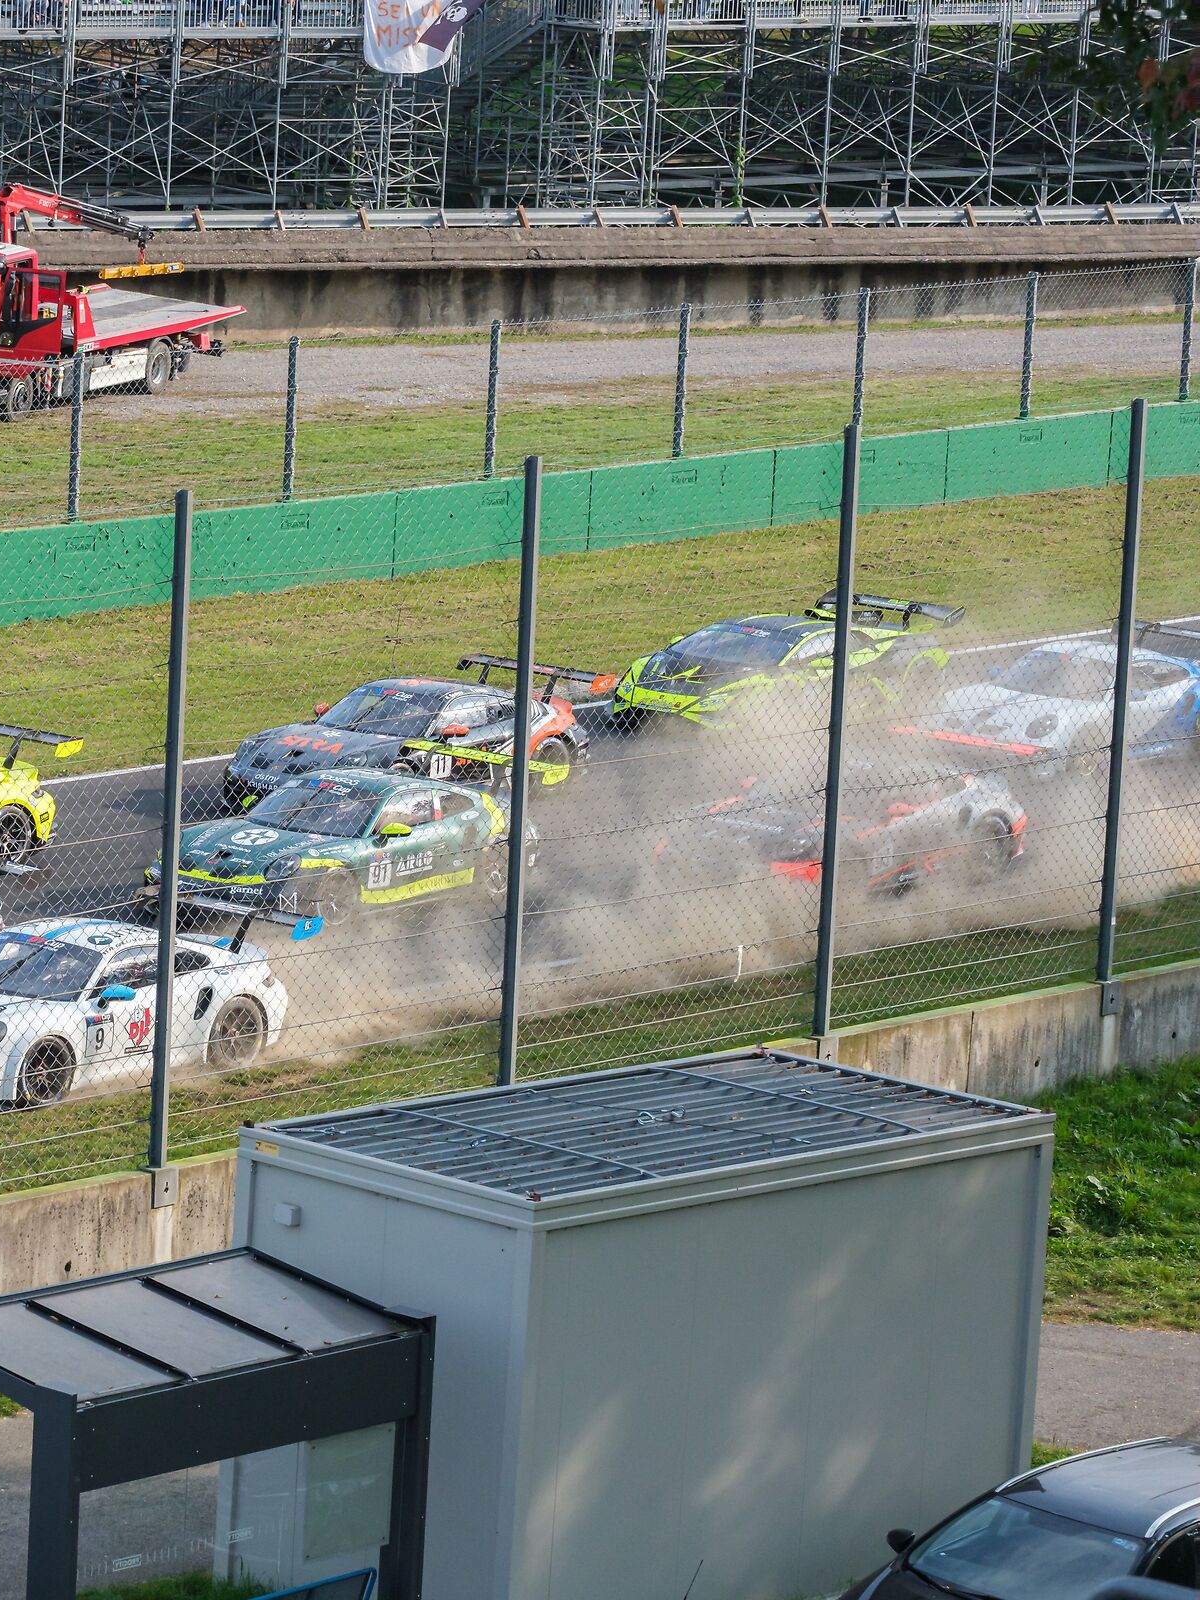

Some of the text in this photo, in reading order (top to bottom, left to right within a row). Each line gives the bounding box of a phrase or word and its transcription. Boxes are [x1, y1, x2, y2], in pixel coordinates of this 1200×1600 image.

[436, 756, 447, 774] 11
[230, 885, 264, 895] garnet
[95, 1027, 105, 1052] 9
